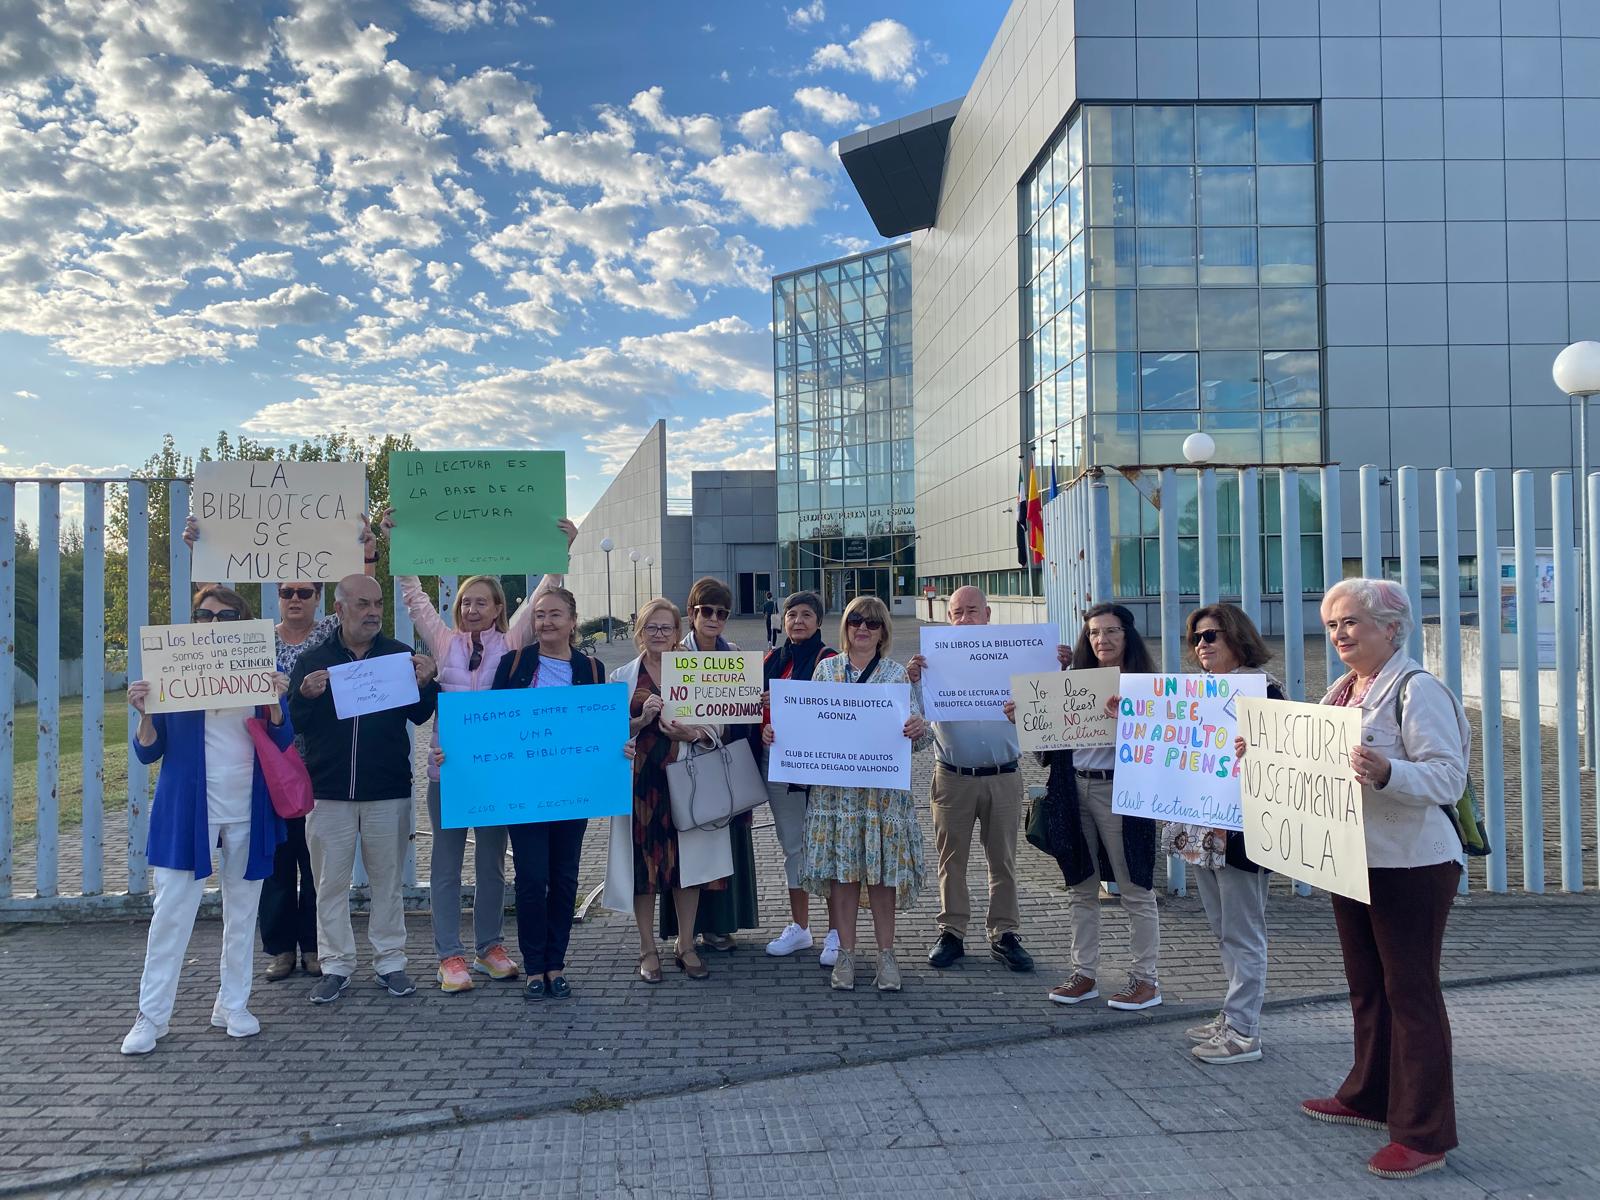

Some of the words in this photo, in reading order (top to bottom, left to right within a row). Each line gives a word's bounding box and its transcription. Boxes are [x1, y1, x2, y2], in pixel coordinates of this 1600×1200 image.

[250, 463, 288, 488] LA
[407, 460, 424, 477] LA
[434, 459, 491, 474] LECTURA
[507, 459, 528, 469] ES
[409, 487, 428, 499] LA
[444, 485, 477, 496] BASE
[488, 484, 508, 494] DE
[202, 492, 346, 520] BIBLIOTECA
[435, 507, 513, 522] CULTURA
[253, 522, 293, 547] SE
[226, 550, 333, 580] MUERE
[167, 630, 186, 647] Los
[935, 641, 949, 650] SIN
[950, 640, 980, 649] LIBROS
[982, 640, 992, 648] LA
[994, 638, 1043, 647] BIBLIOTECA
[172, 651, 204, 662] somos
[210, 648, 228, 658] una
[231, 645, 267, 657] especie
[969, 652, 1009, 661] AGONIZA
[161, 665, 175, 673] en
[181, 662, 212, 677] peligro
[215, 660, 224, 670] de
[675, 657, 698, 669] LOS
[703, 657, 745, 670] CLUBS
[682, 674, 696, 683] DE
[701, 672, 746, 683] LECTURA
[1153, 677, 1178, 697] UN
[1185, 674, 1230, 698] NIÑO
[669, 686, 689, 701] NO
[694, 686, 737, 700] PUEDEN
[738, 686, 762, 697] ESTAR
[957, 689, 967, 697] DE
[1029, 680, 1048, 700] Yo
[1064, 678, 1089, 698] leo
[675, 705, 692, 716] SIN
[695, 702, 763, 717] COORDINADOR
[784, 695, 797, 705] SIN
[799, 696, 829, 706] LIBROS
[830, 698, 841, 707] LA
[843, 699, 893, 708] BIBLIOTECA
[934, 700, 973, 708] BIBLIOTECA
[463, 709, 521, 725] HAGAMOS
[532, 706, 568, 716] ENTRE
[577, 703, 617, 713] TODOS
[817, 711, 857, 721] AGONIZA
[1120, 698, 1155, 717] QUE
[1166, 700, 1203, 726] LEE,
[1023, 713, 1053, 732] Ellos
[1063, 713, 1081, 726] NO
[519, 728, 553, 741] UNA
[1041, 733, 1058, 743] en
[1061, 726, 1109, 742] Cultura
[1121, 722, 1147, 740] UN
[1150, 724, 1228, 749] ADULTO
[1247, 709, 1269, 750] LA
[1274, 711, 1351, 768] LECTURA
[473, 752, 515, 764] MEJOR
[526, 745, 600, 759] BIBLIOTECA
[785, 749, 802, 758] CLUB
[815, 751, 847, 760] LECTURA
[859, 753, 893, 761] ADULTOS
[1119, 743, 1155, 765] QUE
[780, 760, 820, 770] BIBLIOTECA
[821, 763, 855, 772] DELGADO
[857, 765, 899, 773] VALHONDO
[1243, 757, 1262, 799] NO
[1264, 763, 1285, 805] SE
[1287, 767, 1358, 826] FOMENTA
[467, 805, 497, 814] CLUB
[508, 802, 526, 810] DE
[537, 798, 590, 809] LECTURA
[1116, 790, 1145, 810] Club
[1151, 793, 1201, 819] lectura
[1200, 795, 1243, 823] "Adulto
[1260, 811, 1337, 877] SOLA
